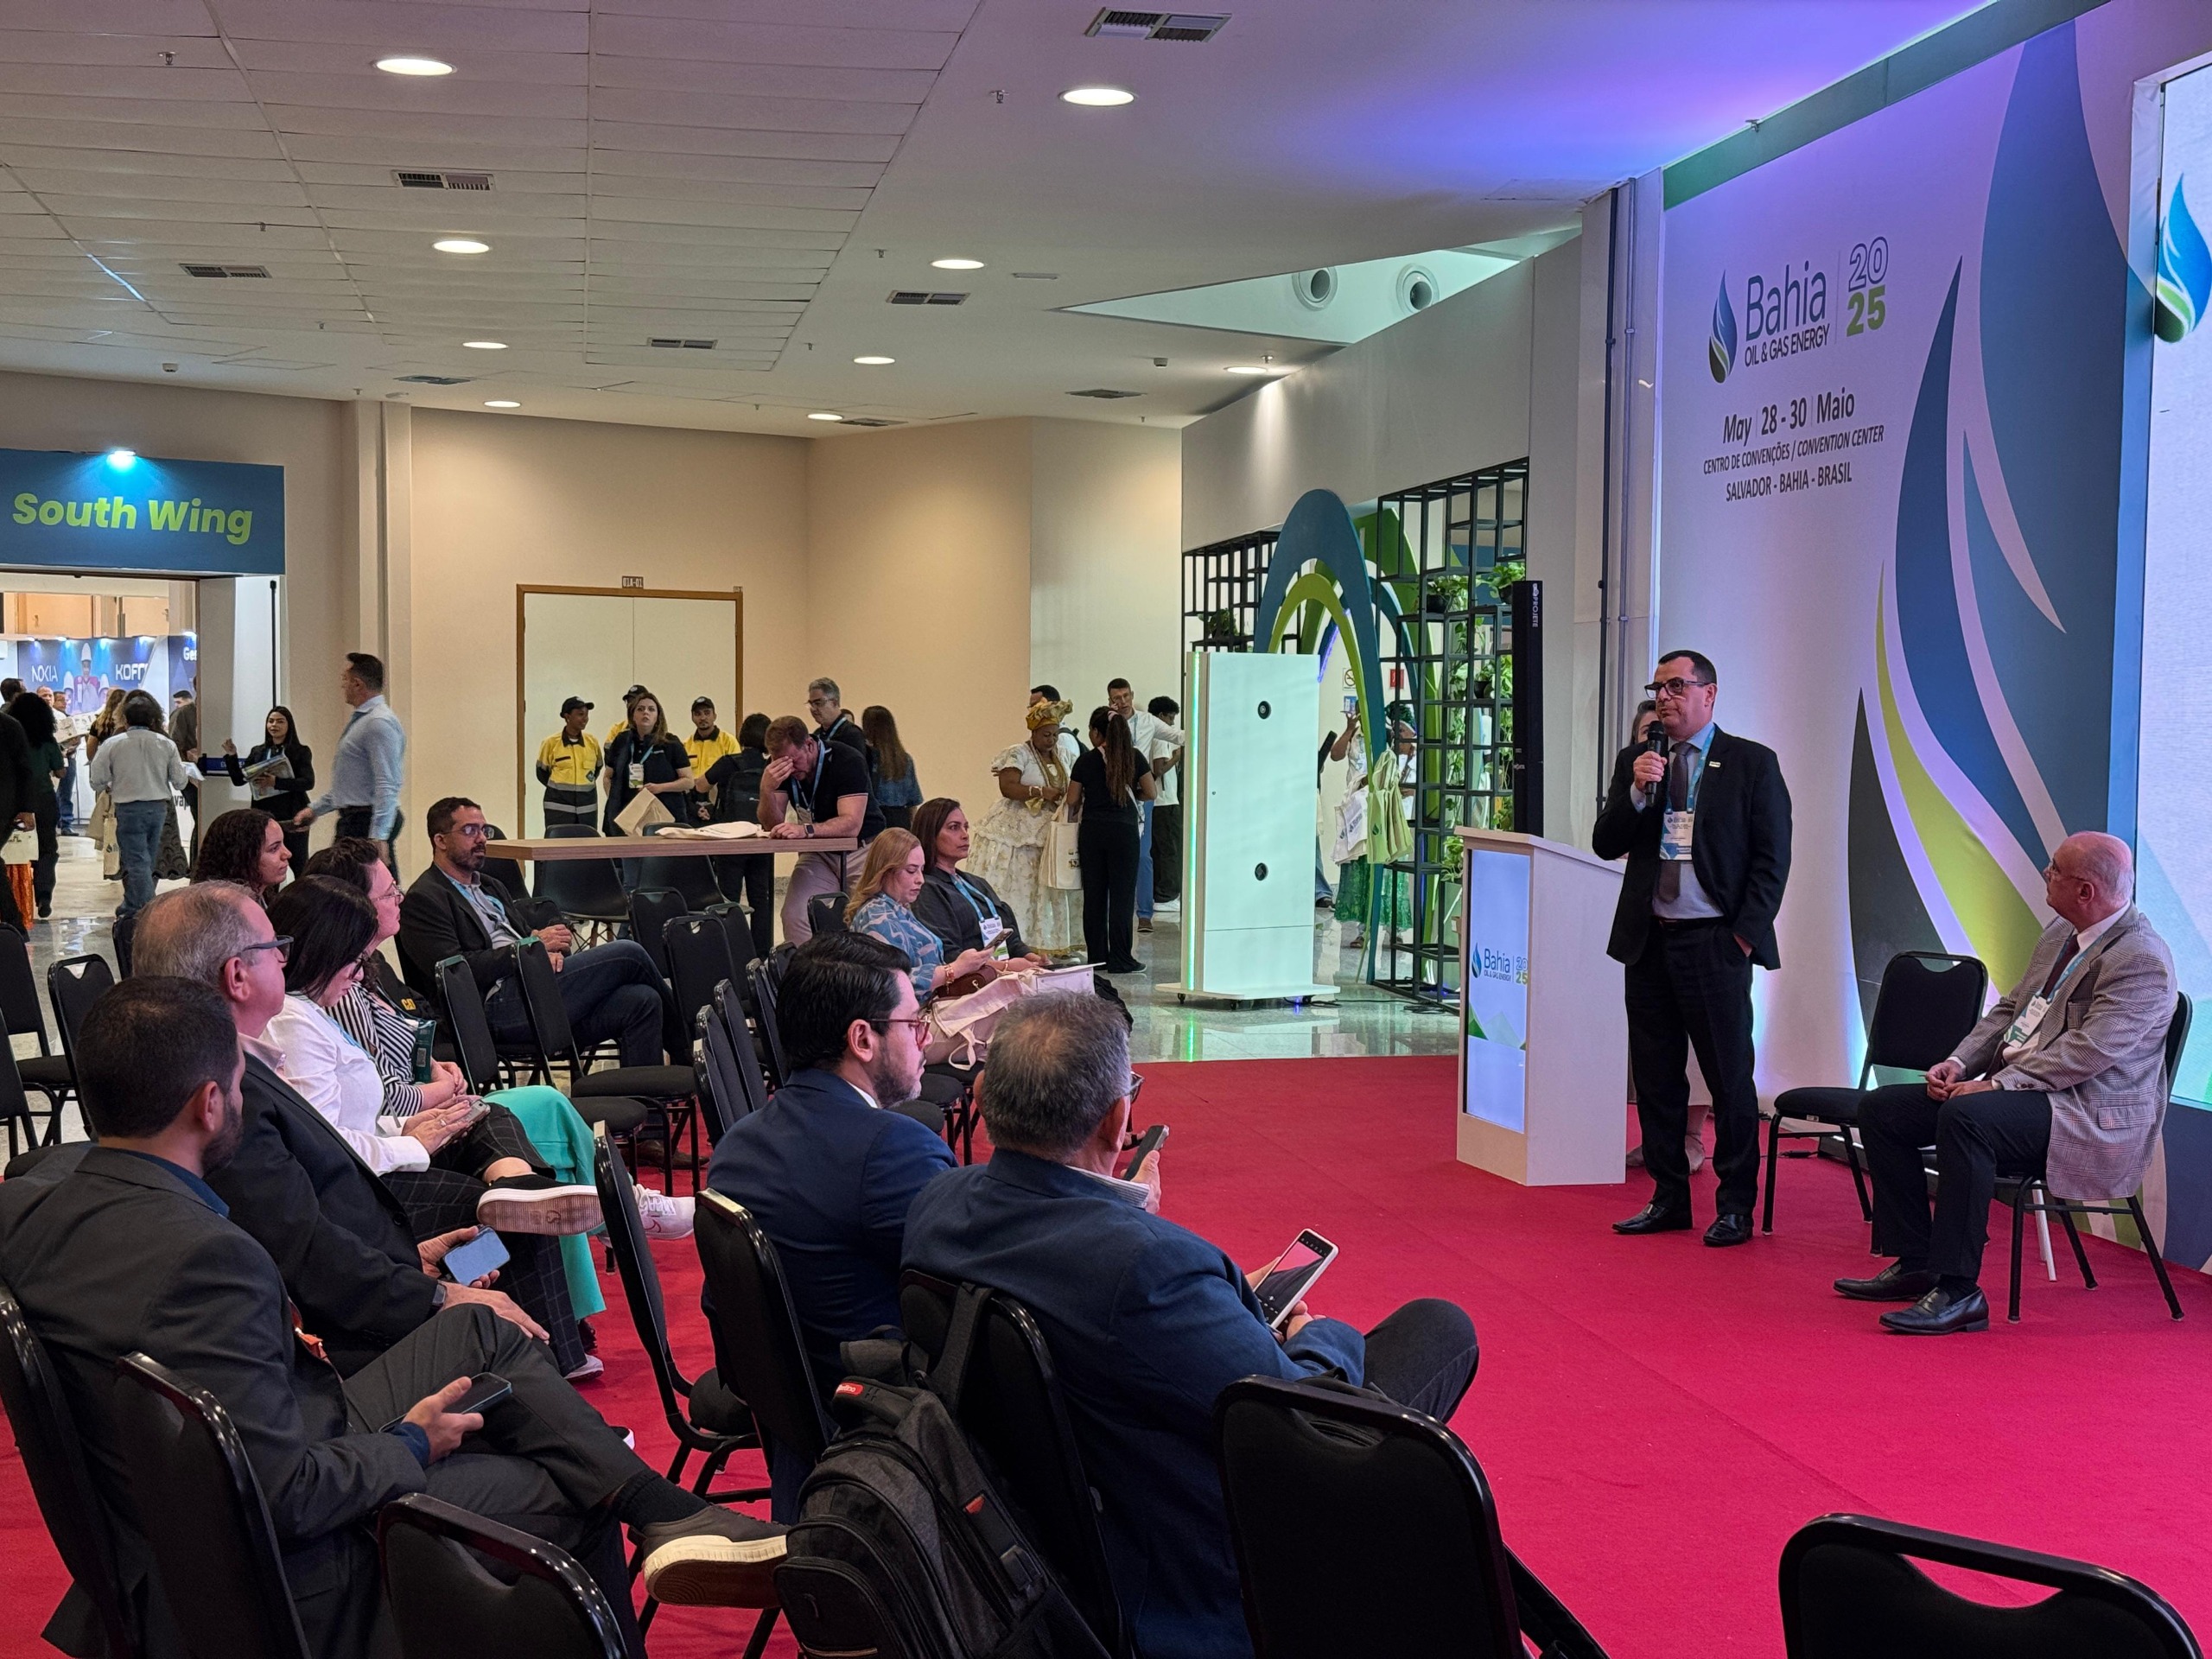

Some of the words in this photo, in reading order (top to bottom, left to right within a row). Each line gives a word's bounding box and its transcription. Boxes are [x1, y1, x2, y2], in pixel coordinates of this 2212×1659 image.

[1848, 236, 1889, 292] 20
[1745, 260, 1827, 342] Bahia
[1846, 284, 1886, 337] 25
[1745, 343, 1760, 367] OIL
[1761, 342, 1768, 363] &
[1769, 334, 1789, 361] GAS
[1791, 323, 1830, 356] ENERGY
[1722, 414, 1752, 447] May
[1761, 404, 1778, 435] 28
[1789, 397, 1808, 429] 30
[1816, 386, 1855, 424] Maio
[1703, 454, 1730, 475] CENTRO
[1732, 452, 1740, 469] DE
[1741, 442, 1790, 467] CONVENÇÕES
[1790, 440, 1796, 462] /
[1796, 432, 1850, 459] CONVENTION
[1852, 423, 1885, 448] CENTER
[1726, 474, 1772, 503] SALVADOR
[1779, 468, 1809, 494] BAHIA
[1817, 461, 1853, 488] BRASIL
[12, 493, 137, 530] South
[148, 498, 253, 545] Wing
[31, 664, 59, 683] NOKIA
[1484, 948, 1510, 974] Bahia
[1516, 956, 1529, 972] 20
[1516, 970, 1529, 985] 25
